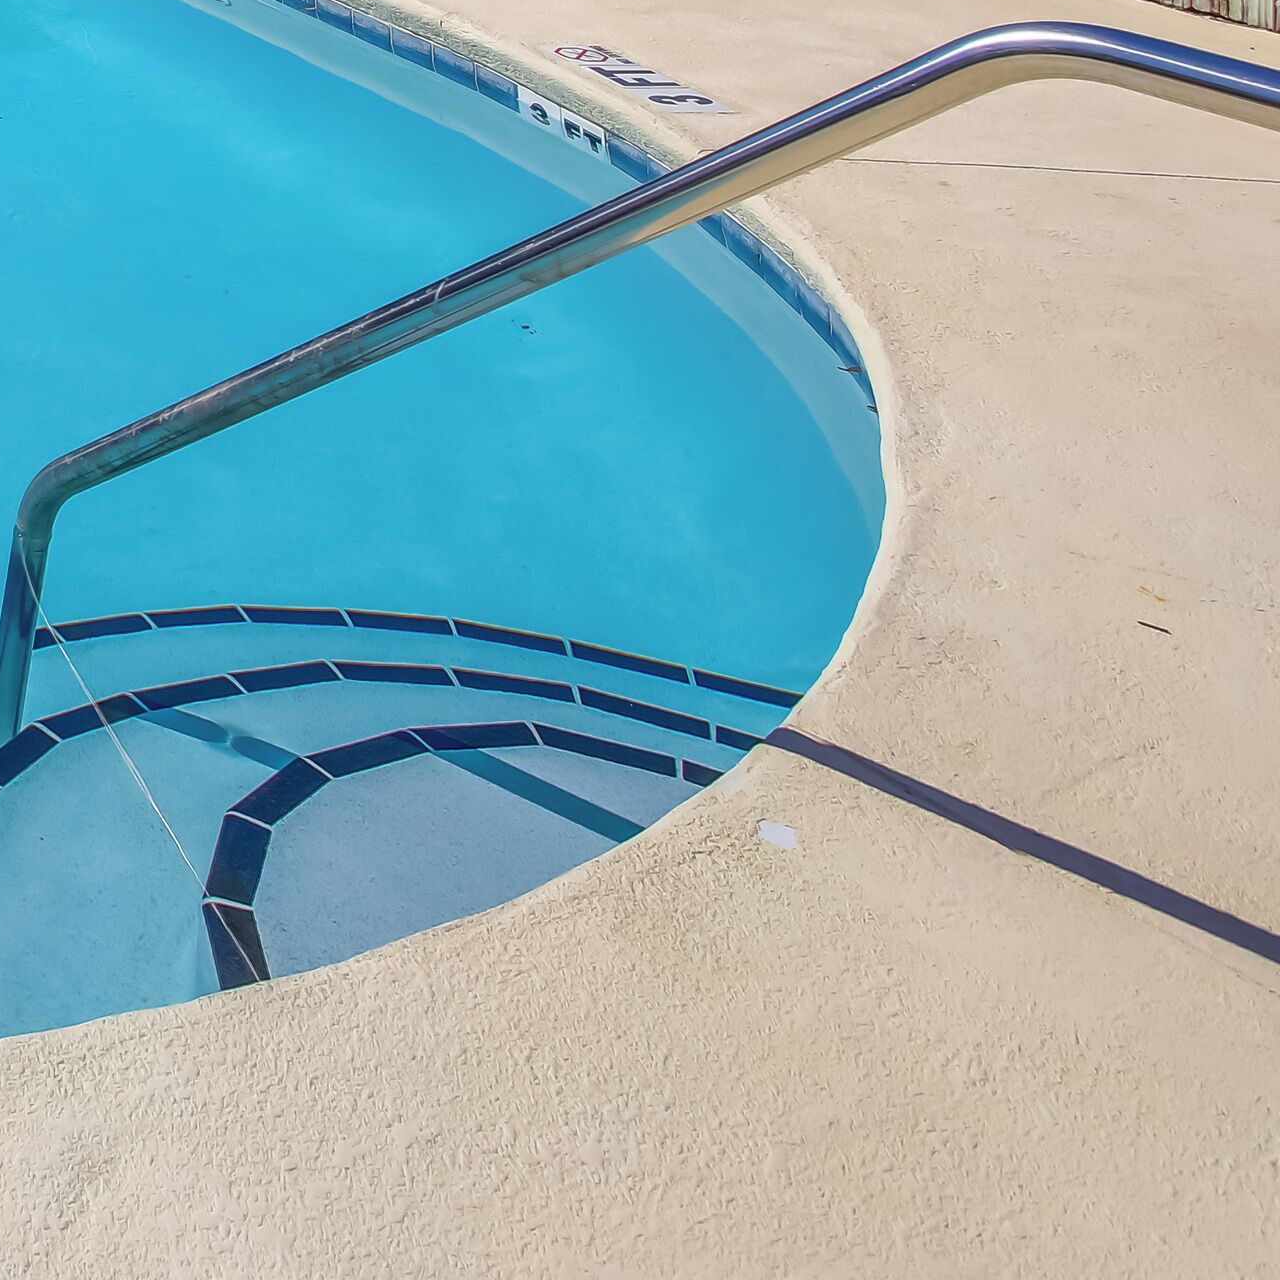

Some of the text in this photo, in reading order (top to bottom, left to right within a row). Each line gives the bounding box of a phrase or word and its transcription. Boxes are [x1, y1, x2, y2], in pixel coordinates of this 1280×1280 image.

[589, 66, 714, 106] 3 FT
[530, 102, 603, 154] 3 FT
